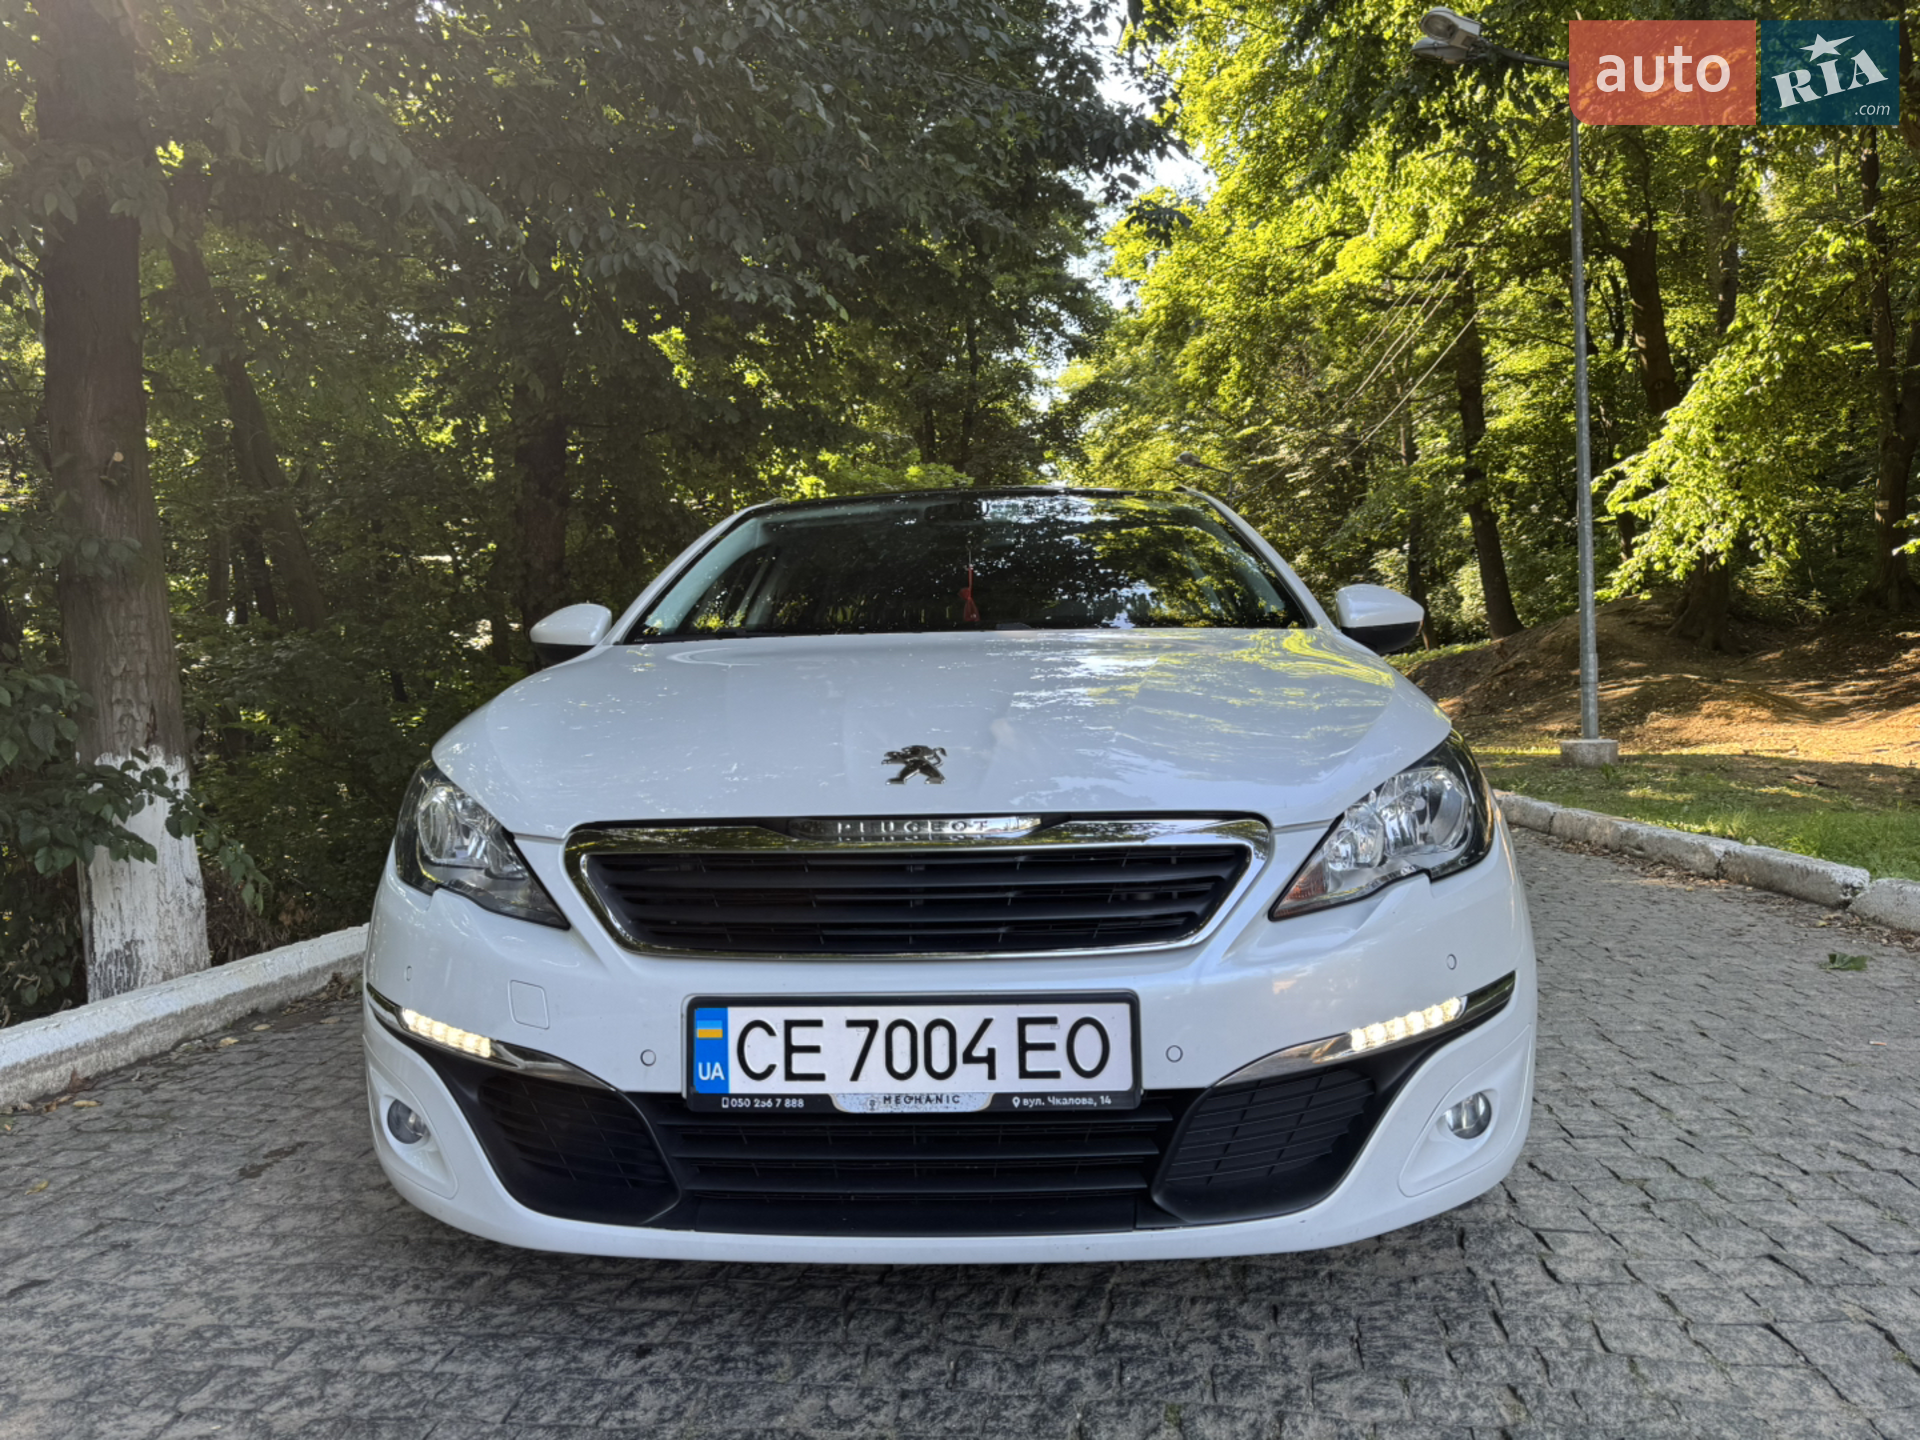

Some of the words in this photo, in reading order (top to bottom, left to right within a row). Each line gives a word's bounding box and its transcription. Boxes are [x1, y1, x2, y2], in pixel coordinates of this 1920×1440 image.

[736, 1019, 826, 1082] CE
[845, 1017, 997, 1082] 7004
[1016, 1016, 1110, 1080] EO
[698, 1062, 725, 1081] UA
[730, 1098, 751, 1108] 050
[1099, 1095, 1112, 1105] 14
